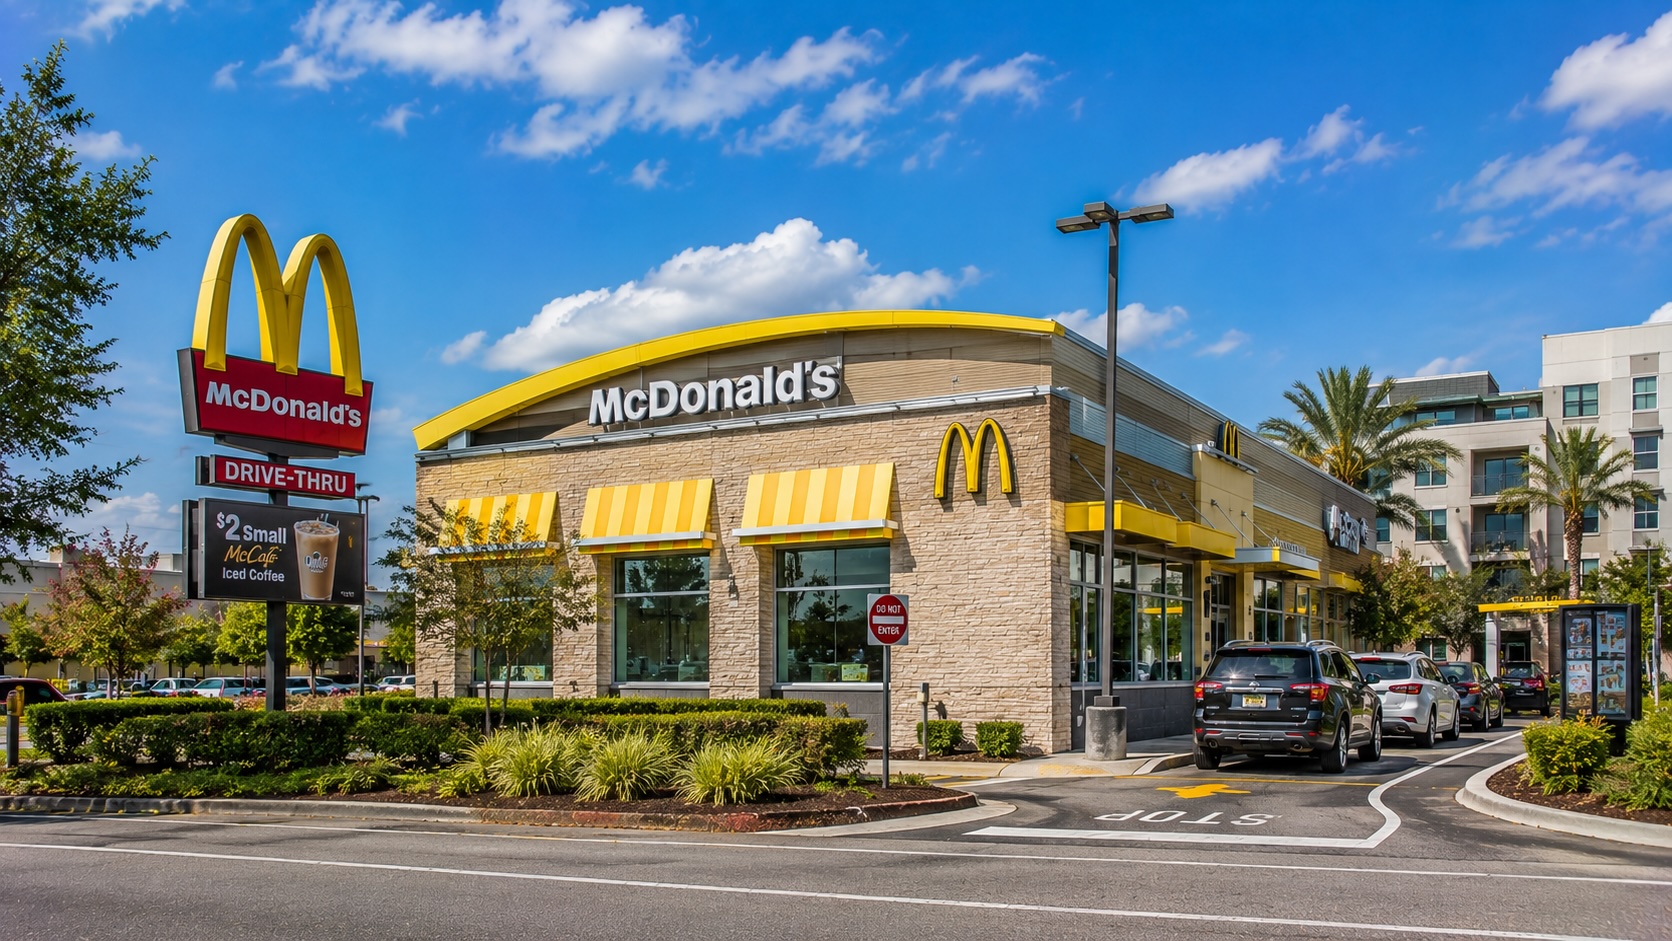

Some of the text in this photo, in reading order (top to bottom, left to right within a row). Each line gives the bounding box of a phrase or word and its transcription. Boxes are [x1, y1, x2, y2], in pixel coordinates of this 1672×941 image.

[205, 381, 362, 428] McDonald's
[589, 360, 842, 426] McDonald's
[225, 461, 347, 493] DRIVE-THRU
[216, 511, 287, 544] $2 Small
[222, 567, 285, 582] Iced Coffee
[876, 604, 901, 614] DO NOT
[877, 625, 900, 635] ENTER
[1094, 810, 1274, 826] STOP
